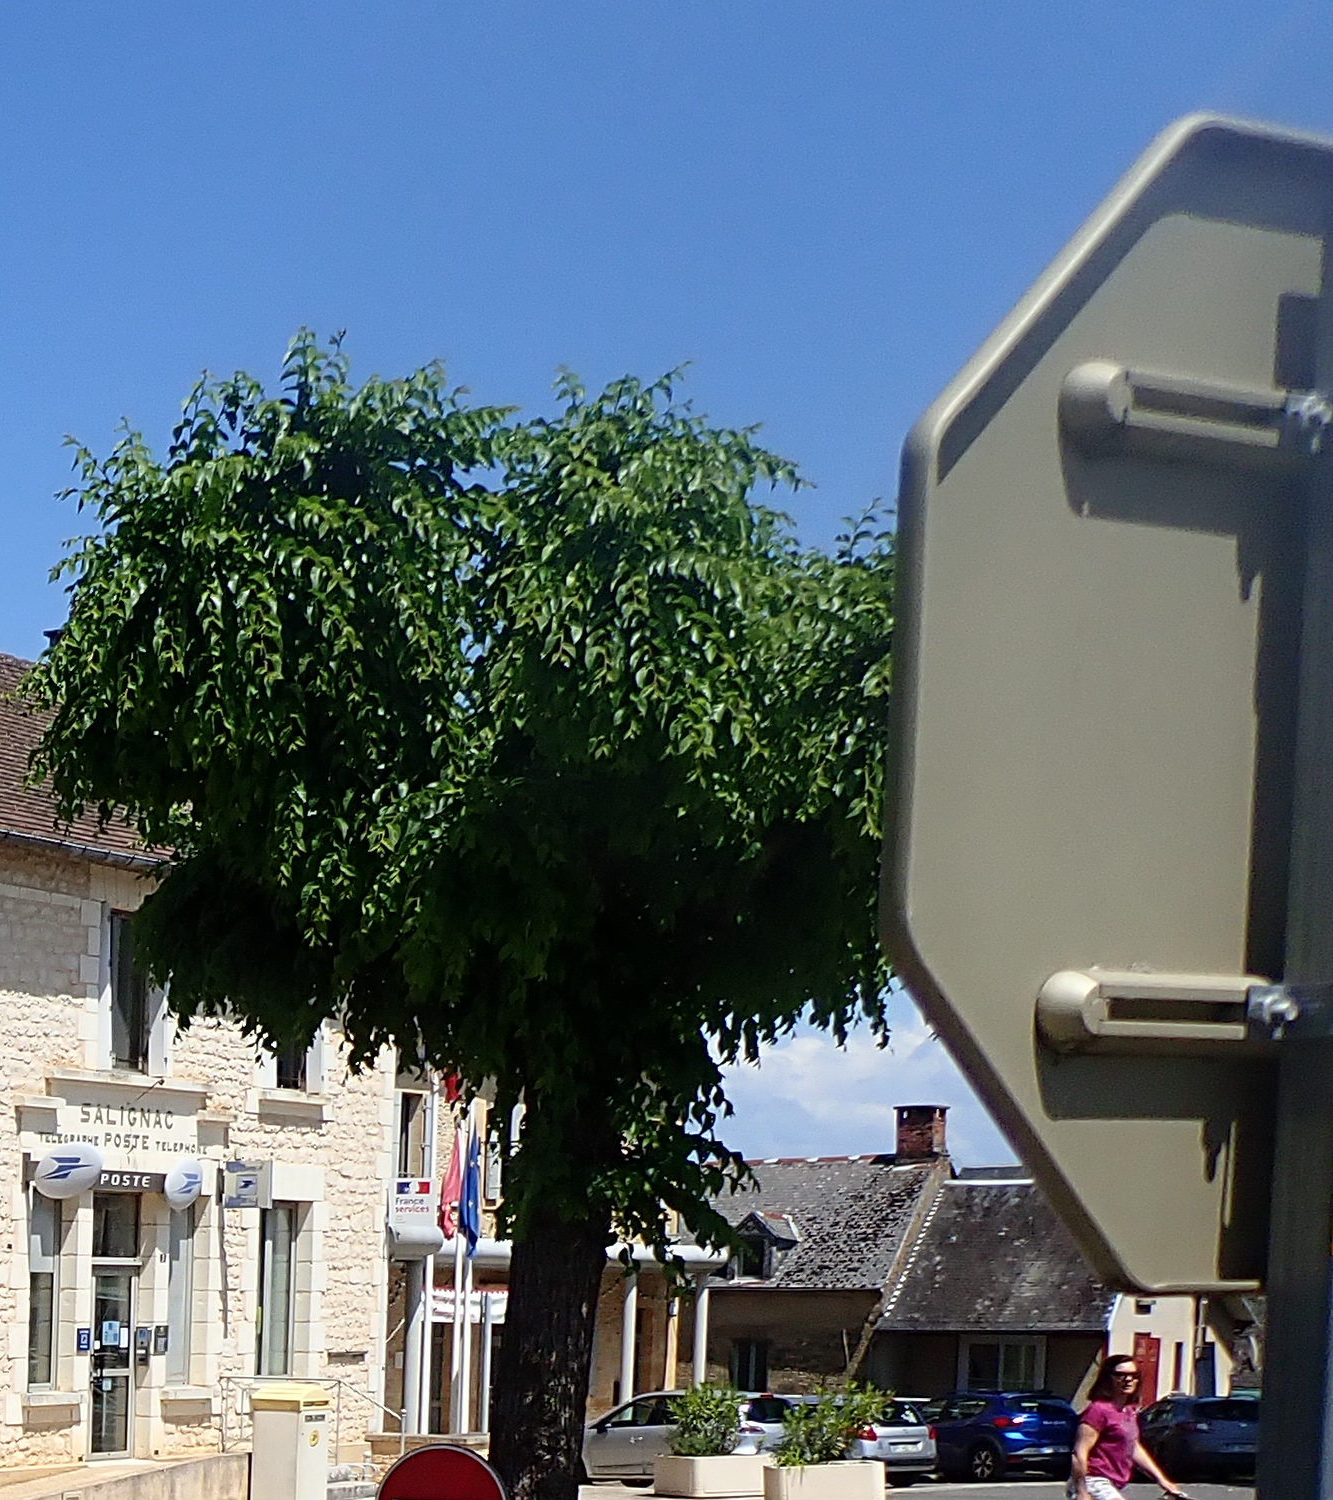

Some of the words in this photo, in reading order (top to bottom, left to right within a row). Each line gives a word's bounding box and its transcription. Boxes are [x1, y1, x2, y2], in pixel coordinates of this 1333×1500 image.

[79, 1102, 175, 1130] SALIGNAC
[39, 1131, 100, 1147] TELEGRAPHE
[103, 1131, 150, 1151] POSTE
[99, 1172, 151, 1189] POSTE
[394, 1205, 430, 1214] services
[395, 1196, 425, 1206] France
